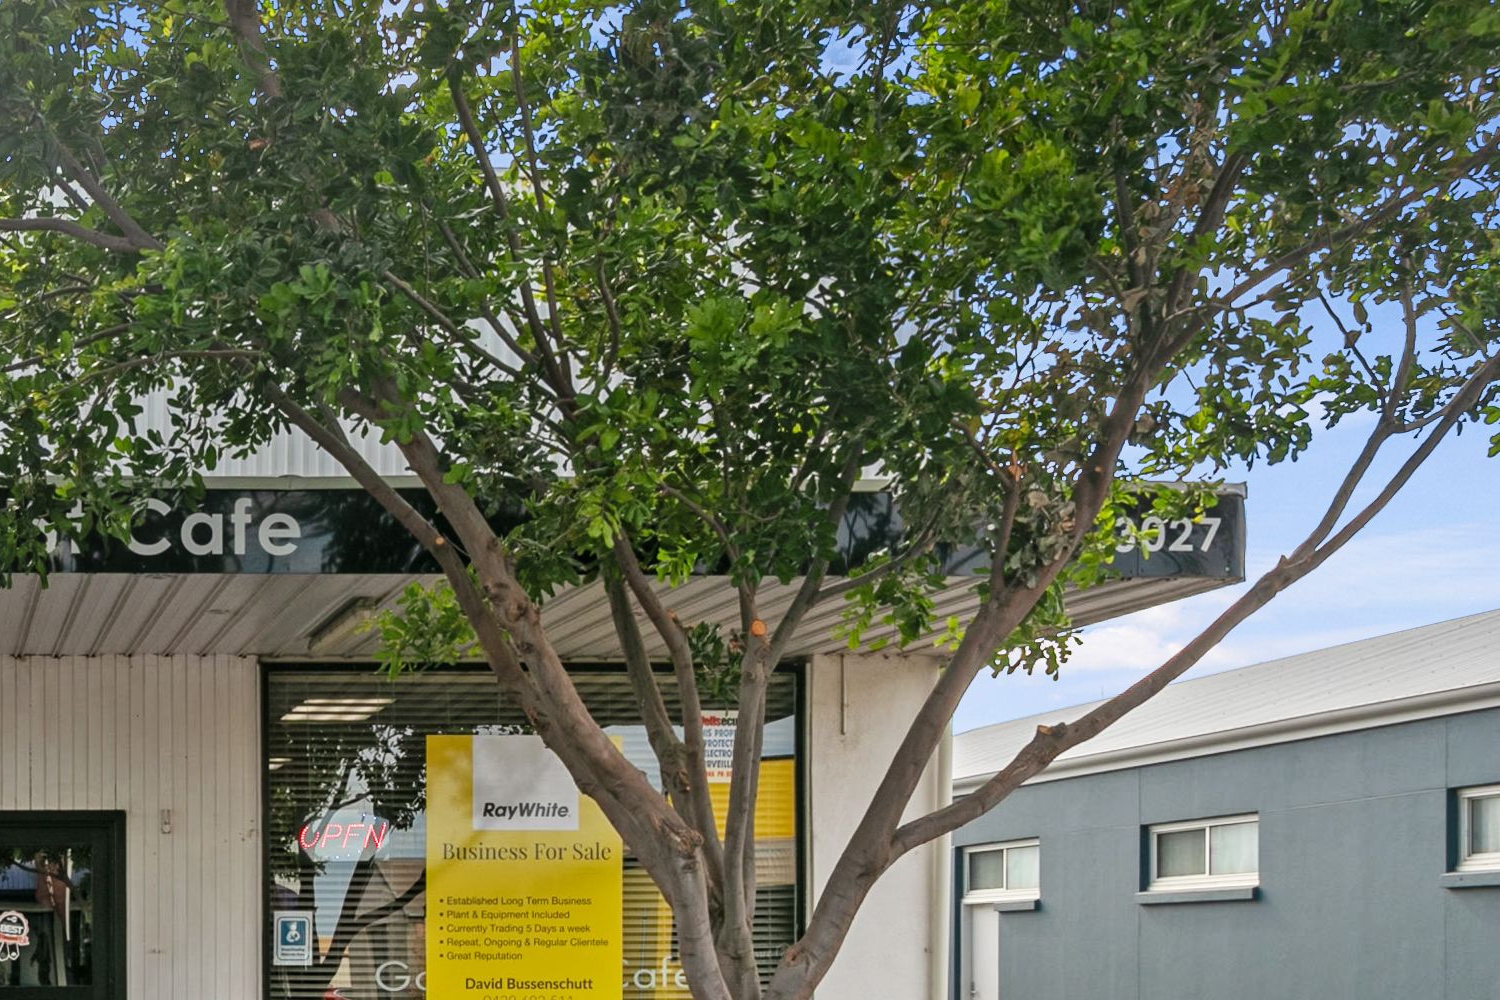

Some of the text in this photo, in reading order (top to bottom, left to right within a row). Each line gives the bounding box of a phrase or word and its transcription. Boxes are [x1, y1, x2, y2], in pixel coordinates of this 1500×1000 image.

[126, 497, 301, 556] Cafe
[483, 802, 569, 821] RayWhite
[443, 842, 612, 861] Business For Sale
[446, 896, 592, 908] Established Long Term Business
[446, 910, 570, 921] Plant & Equipment Included
[446, 924, 488, 934] Currently
[490, 924, 524, 934] Trading
[526, 924, 532, 933] 5
[534, 924, 557, 934] Days
[567, 924, 590, 933] week
[446, 937, 609, 948] Repeat, Ongoing & Regular Clientele
[446, 952, 523, 962] Great Reputation
[465, 977, 594, 990] David Bussenschutt
